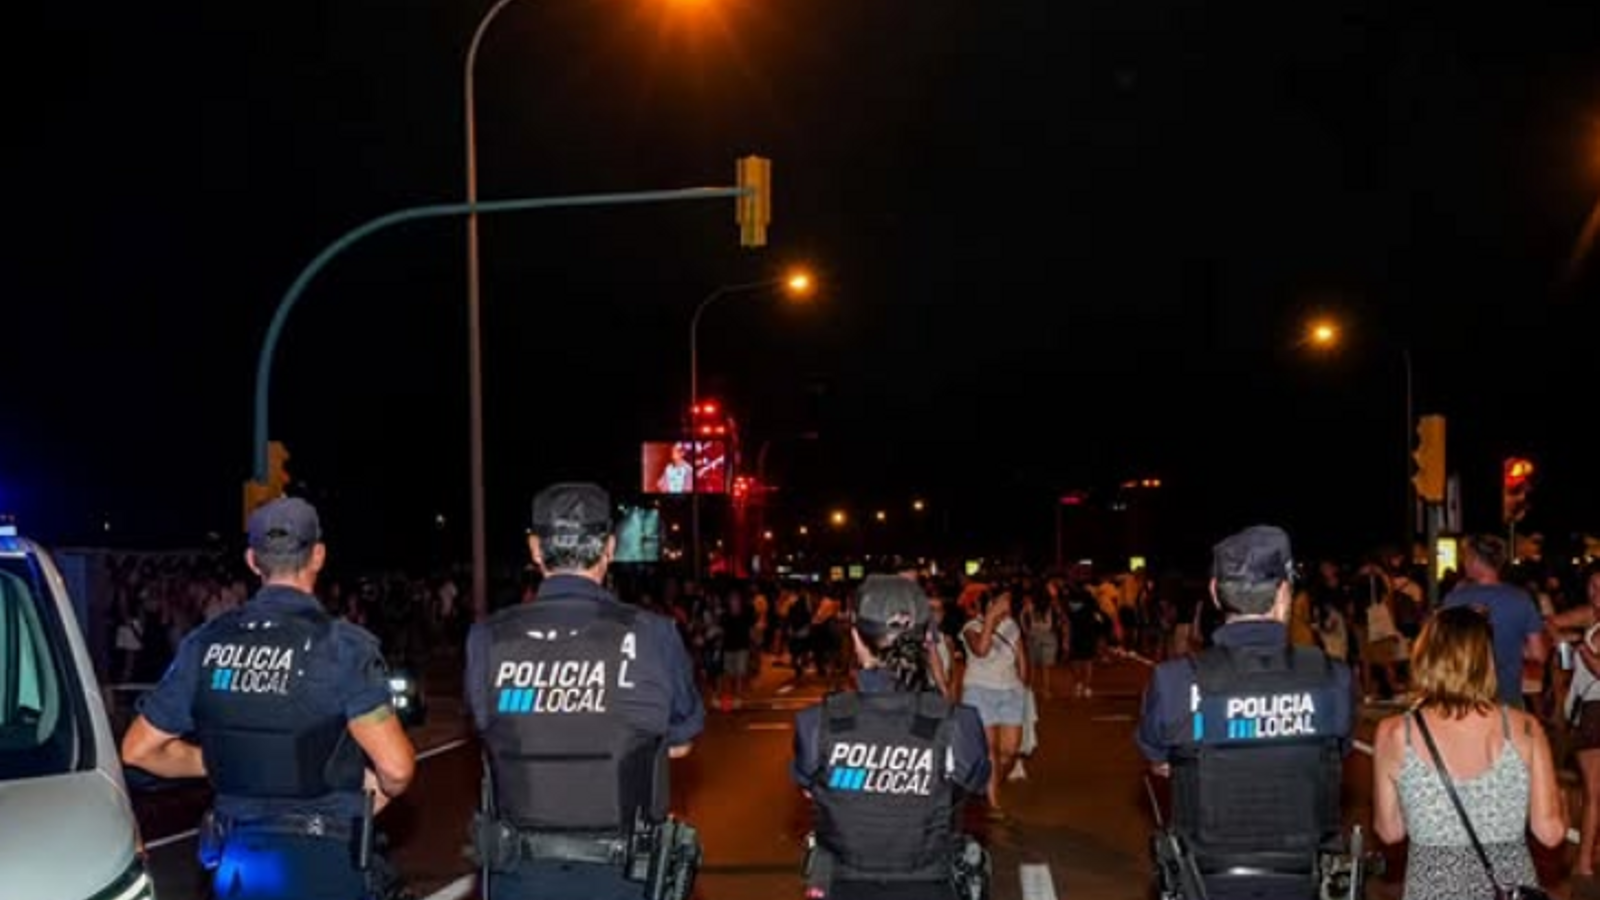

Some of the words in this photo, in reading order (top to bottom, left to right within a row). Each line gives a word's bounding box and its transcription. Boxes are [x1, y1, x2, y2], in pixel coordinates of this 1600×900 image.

[202, 643, 294, 670] POLICIA
[230, 669, 290, 694] LOCAL
[495, 660, 606, 687] POLICIA
[533, 687, 606, 712] LOCAL
[1227, 693, 1316, 719] POLICIA
[1255, 713, 1316, 738] LOCAL
[829, 742, 934, 771] POLICIA
[863, 768, 931, 795] LOCAL
